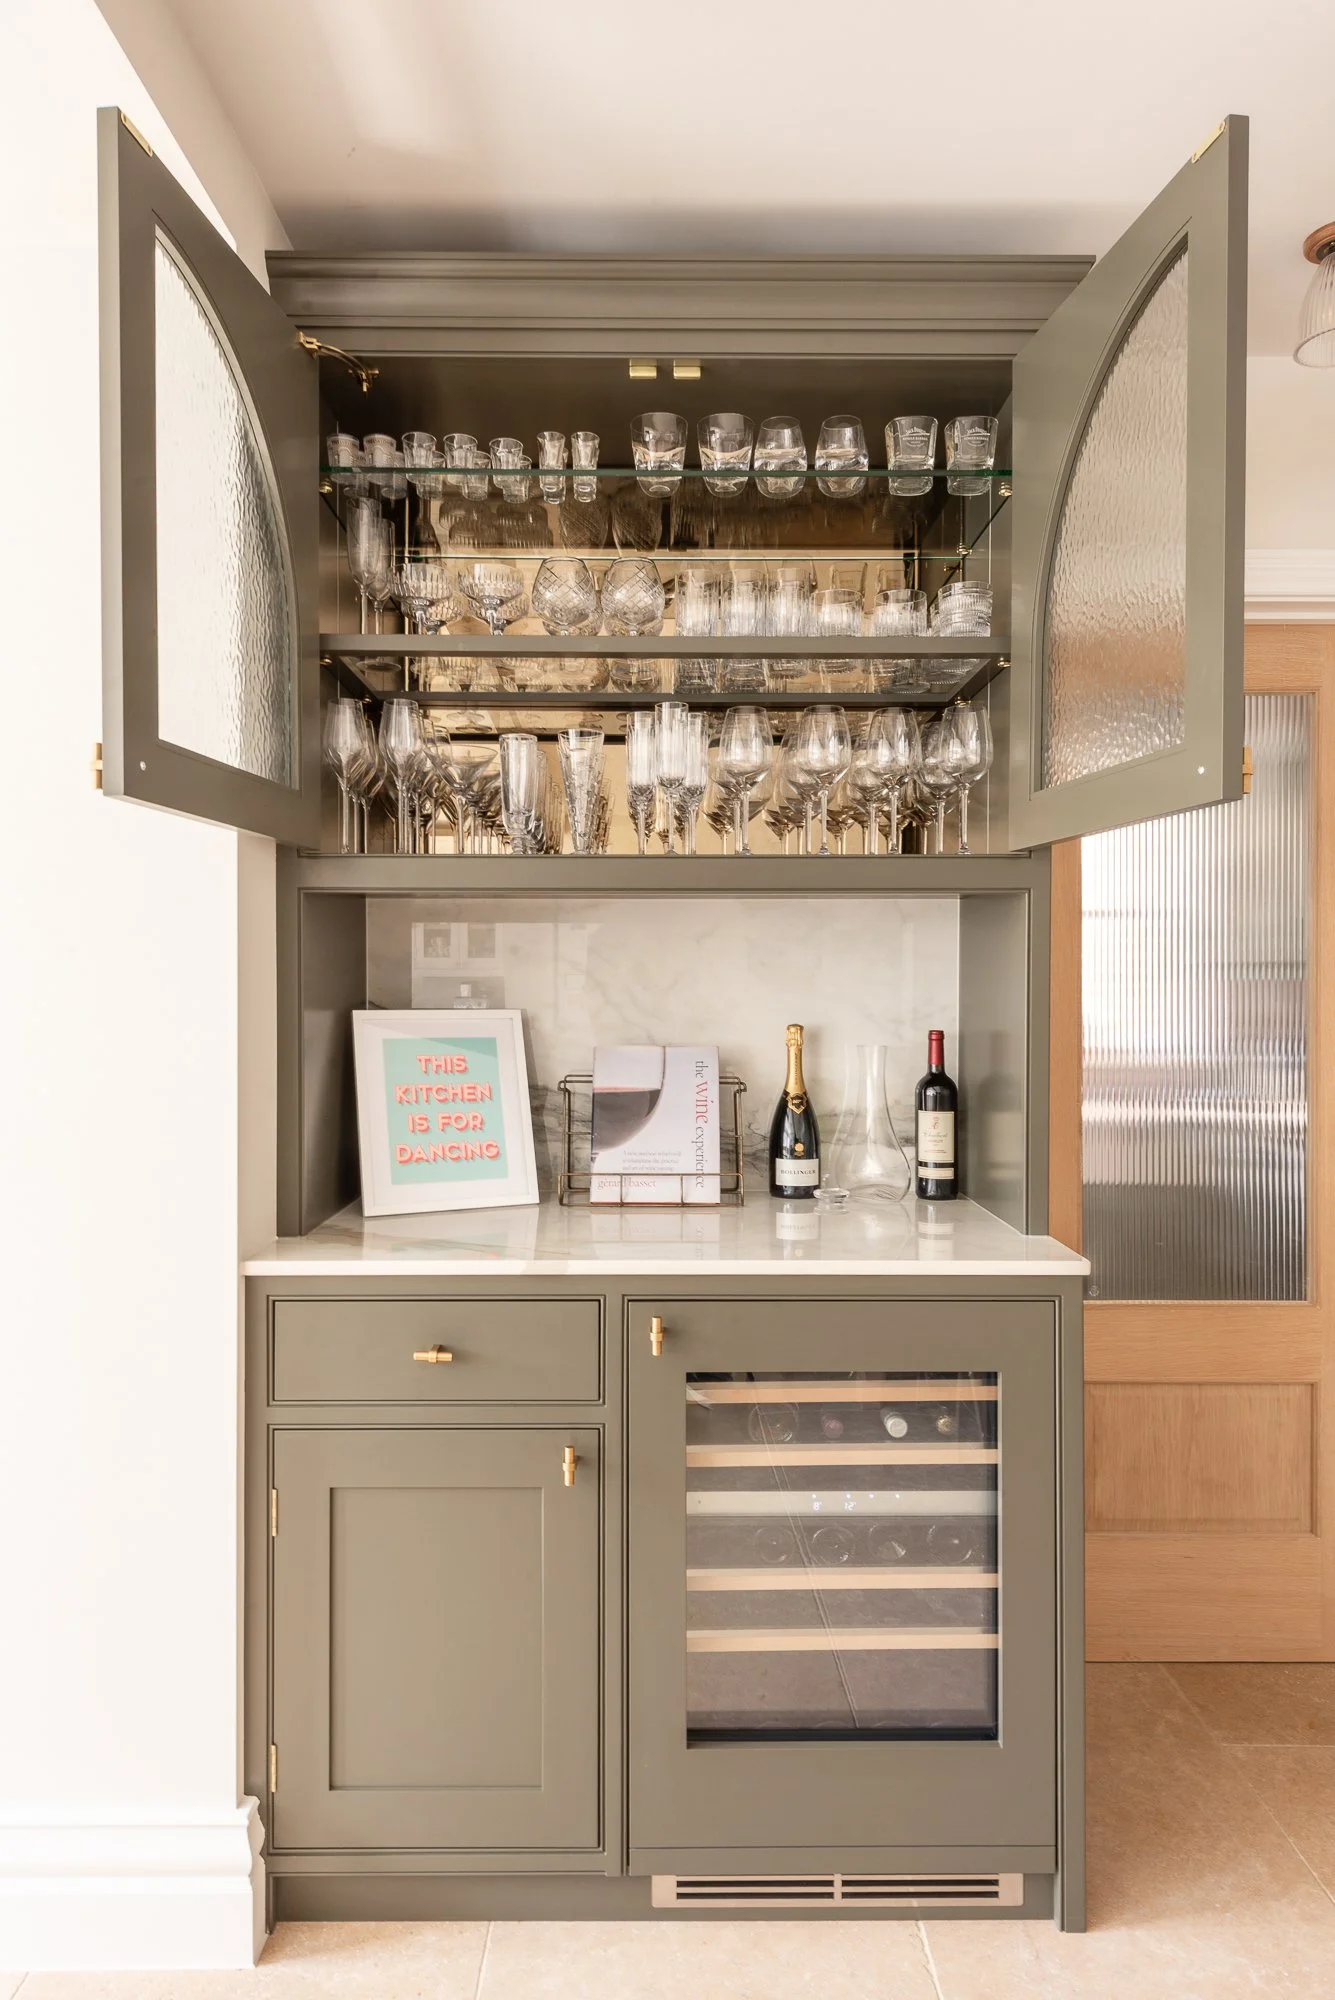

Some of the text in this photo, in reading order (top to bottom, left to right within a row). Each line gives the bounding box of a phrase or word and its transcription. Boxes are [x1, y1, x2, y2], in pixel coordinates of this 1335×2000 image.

[417, 1054, 469, 1075] THIS
[695, 1060, 709, 1078] the
[394, 1082, 493, 1105] KITCHEN
[694, 1081, 714, 1124] wine
[407, 1111, 485, 1134] IS FOR
[395, 1140, 501, 1165] DANCING
[628, 1176, 657, 1188] basset
